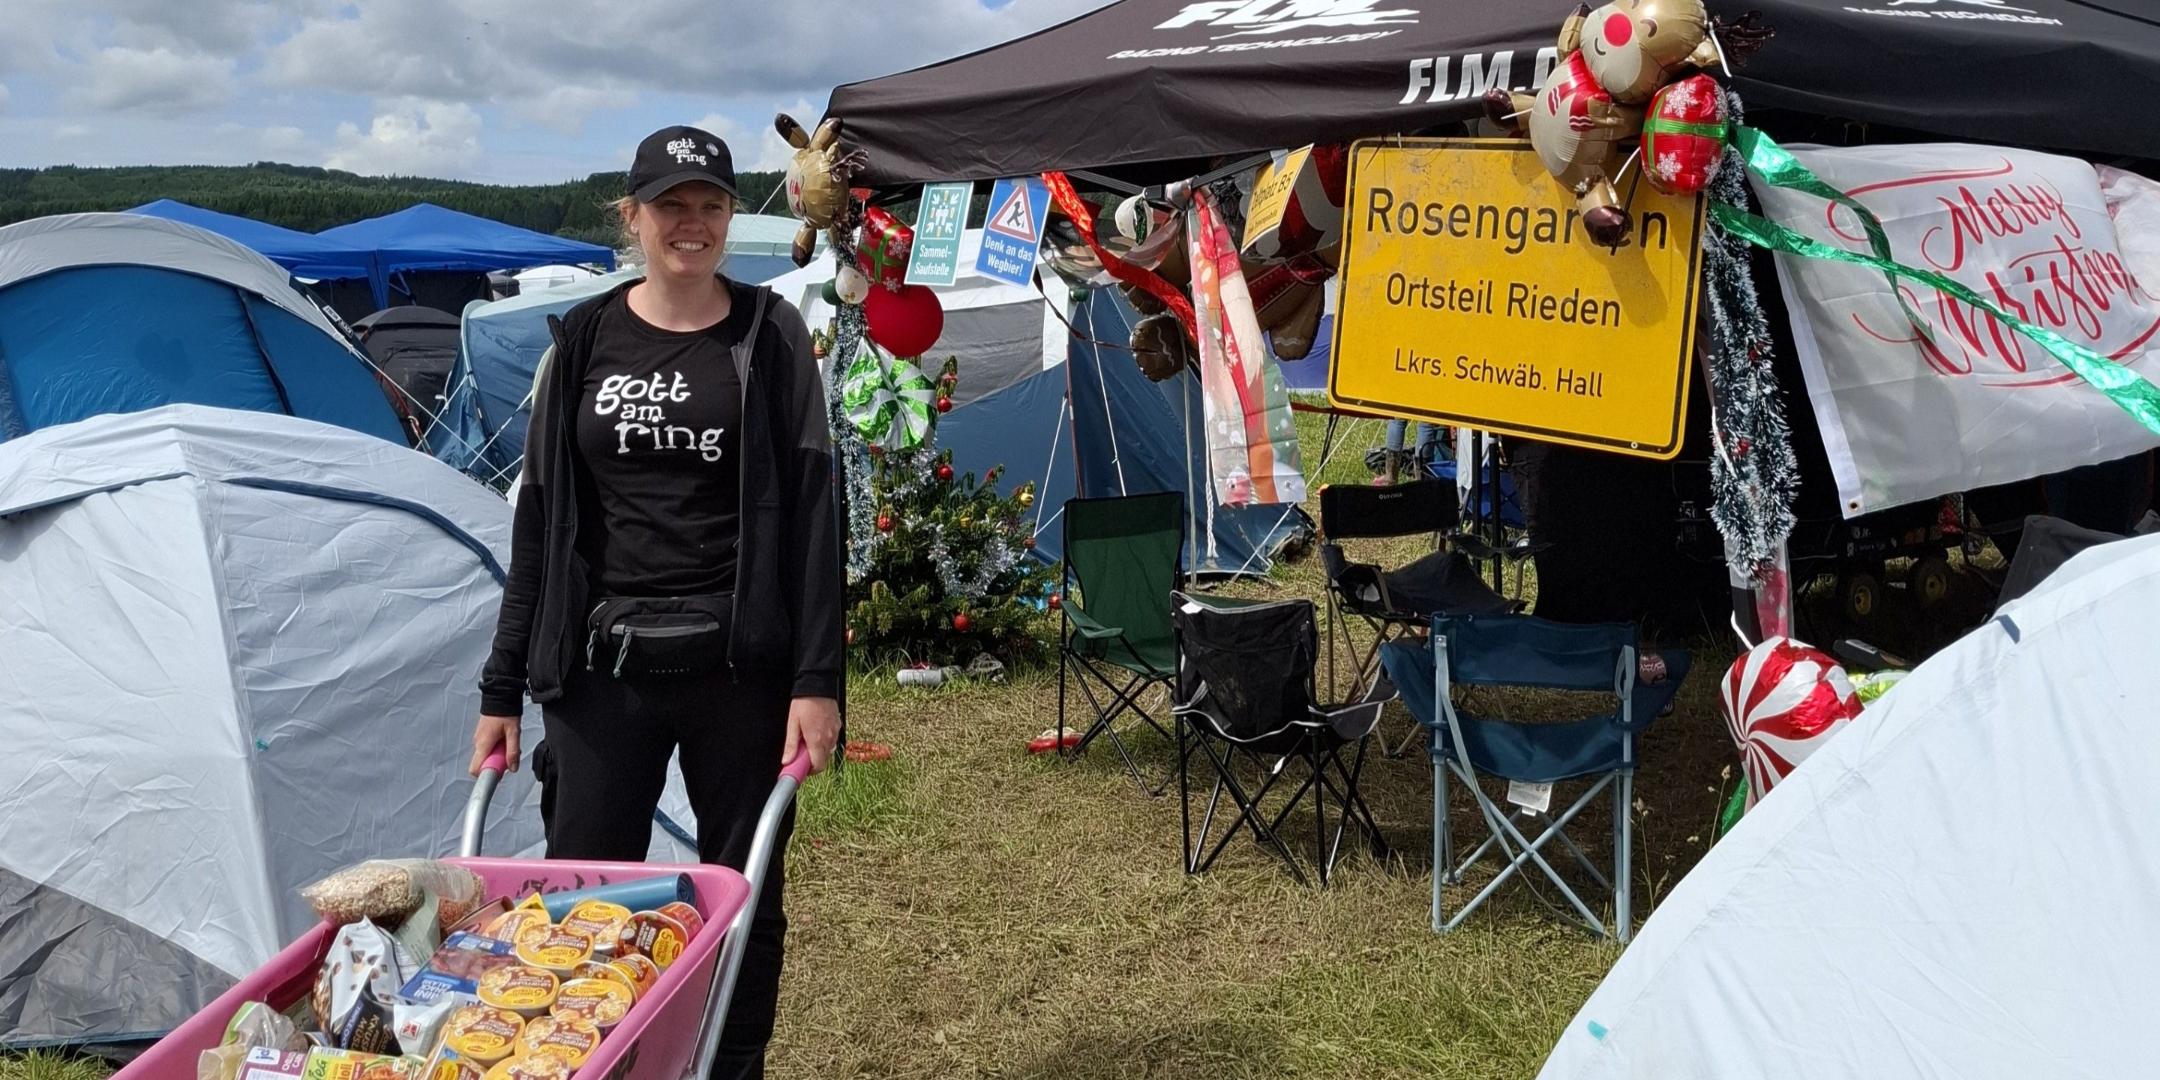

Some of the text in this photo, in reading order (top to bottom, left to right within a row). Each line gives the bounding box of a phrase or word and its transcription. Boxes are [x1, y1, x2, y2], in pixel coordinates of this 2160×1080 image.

[1106, 29, 1403, 59] RACING TECHNOLOGY
[666, 138, 696, 155] gott
[676, 153, 707, 166] ring
[1367, 187, 1668, 254] Rosengaren
[1922, 172, 2081, 271] Merry
[984, 235, 1033, 261] Denk an das
[987, 253, 1023, 275] Wegbier!
[1386, 272, 1621, 328] Ortsteil Rieden
[1394, 348, 1603, 398] Lkrs. Schwäb. Hall
[595, 371, 691, 415] gott
[620, 403, 666, 421] am
[614, 416, 725, 462] ring
